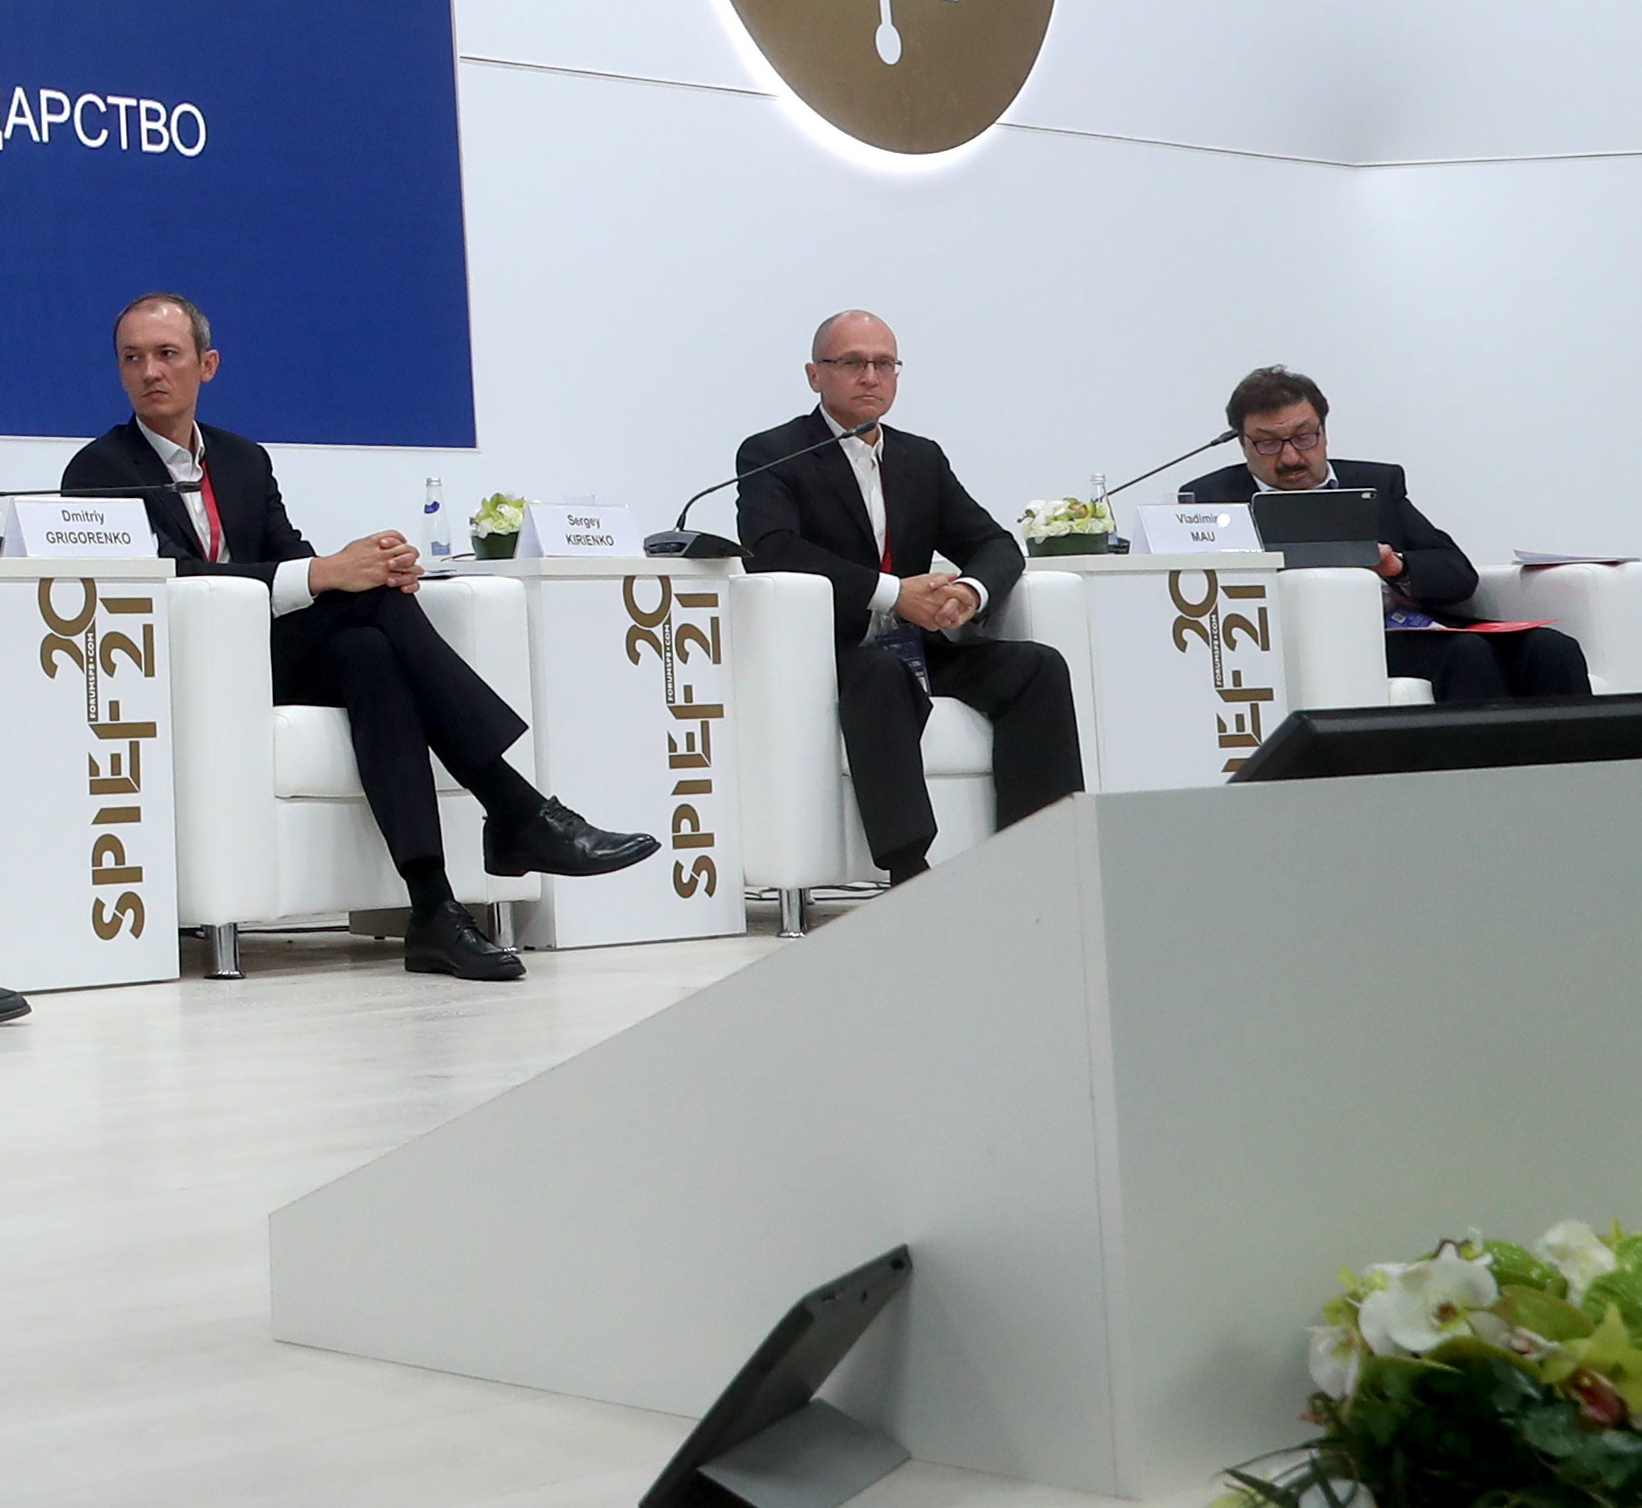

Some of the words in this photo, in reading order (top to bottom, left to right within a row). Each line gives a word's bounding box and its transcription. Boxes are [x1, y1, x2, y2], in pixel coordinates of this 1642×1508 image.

[45, 531, 132, 545] GRIGORENKO
[61, 509, 105, 526] Dmitriy
[566, 514, 600, 530] Sergey
[1190, 531, 1216, 542] MAU
[565, 533, 615, 546] KIRIENKO
[99, 597, 156, 679] 21
[674, 593, 722, 665] 21
[1220, 585, 1271, 652] 21
[667, 684, 725, 899] SPIEF
[88, 700, 157, 941] SPIEF
